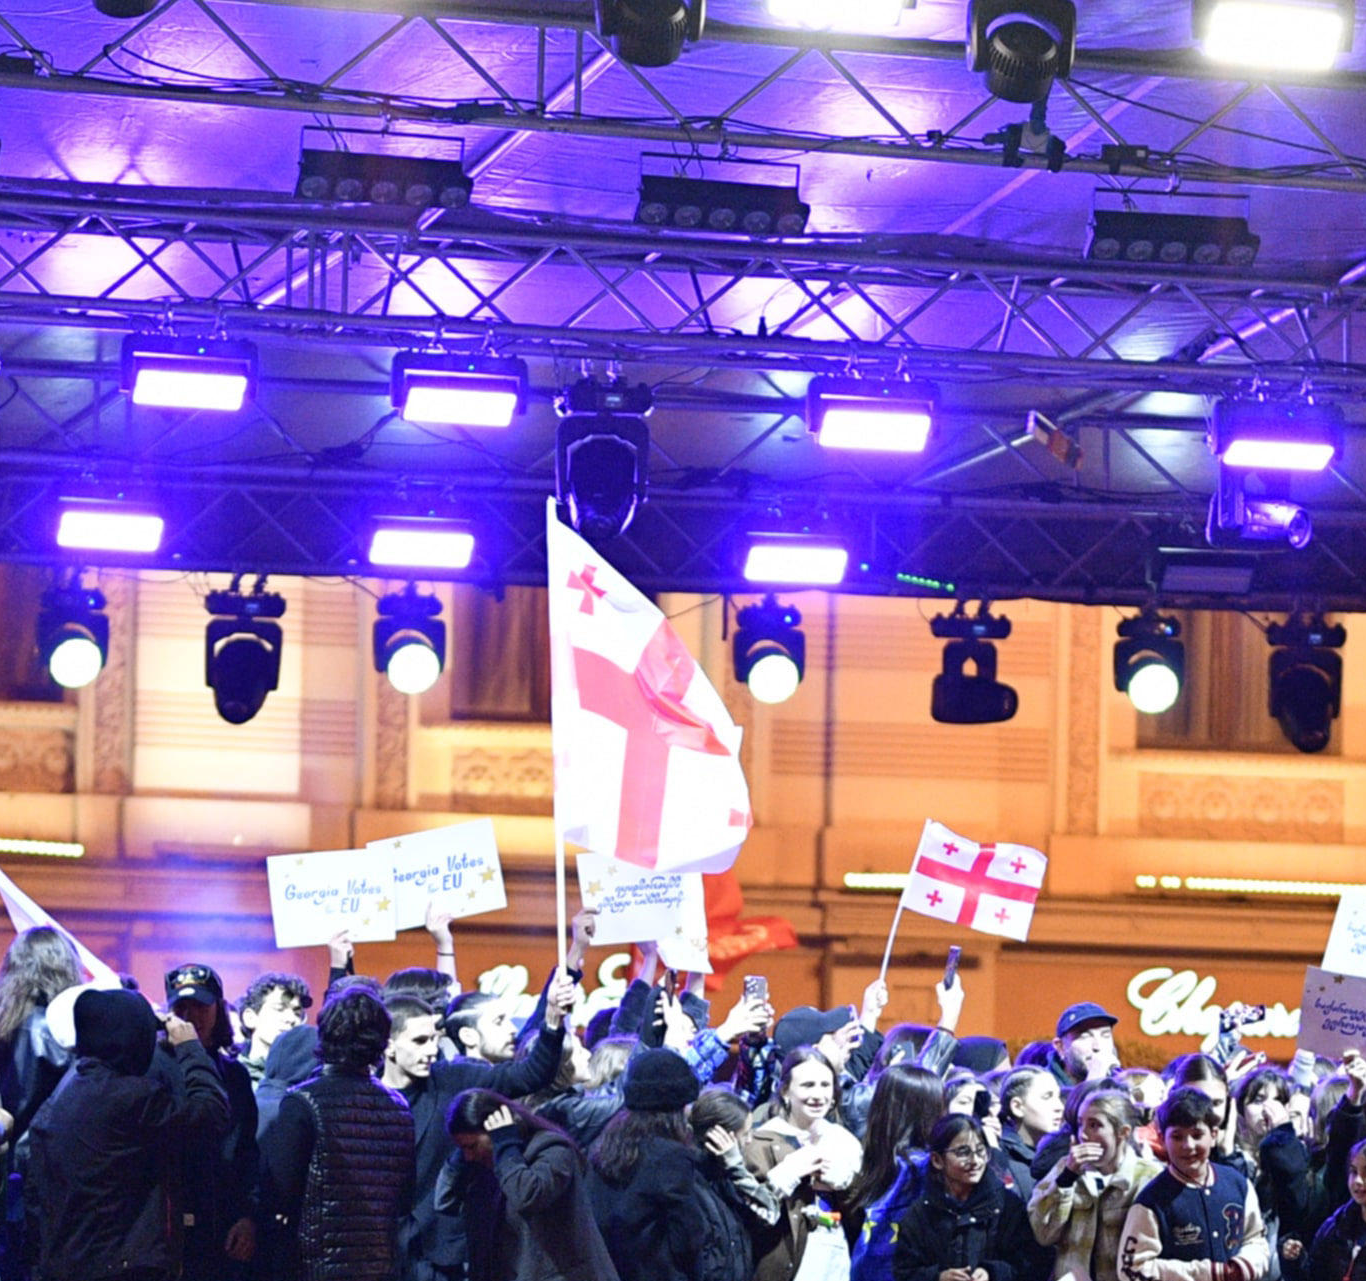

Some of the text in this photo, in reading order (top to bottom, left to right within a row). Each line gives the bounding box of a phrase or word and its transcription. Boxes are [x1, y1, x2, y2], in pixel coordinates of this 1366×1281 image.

[447, 853, 483, 872] Votes
[442, 873, 462, 891] EU
[285, 879, 382, 905] Georgia Votes
[340, 897, 360, 914] EU
